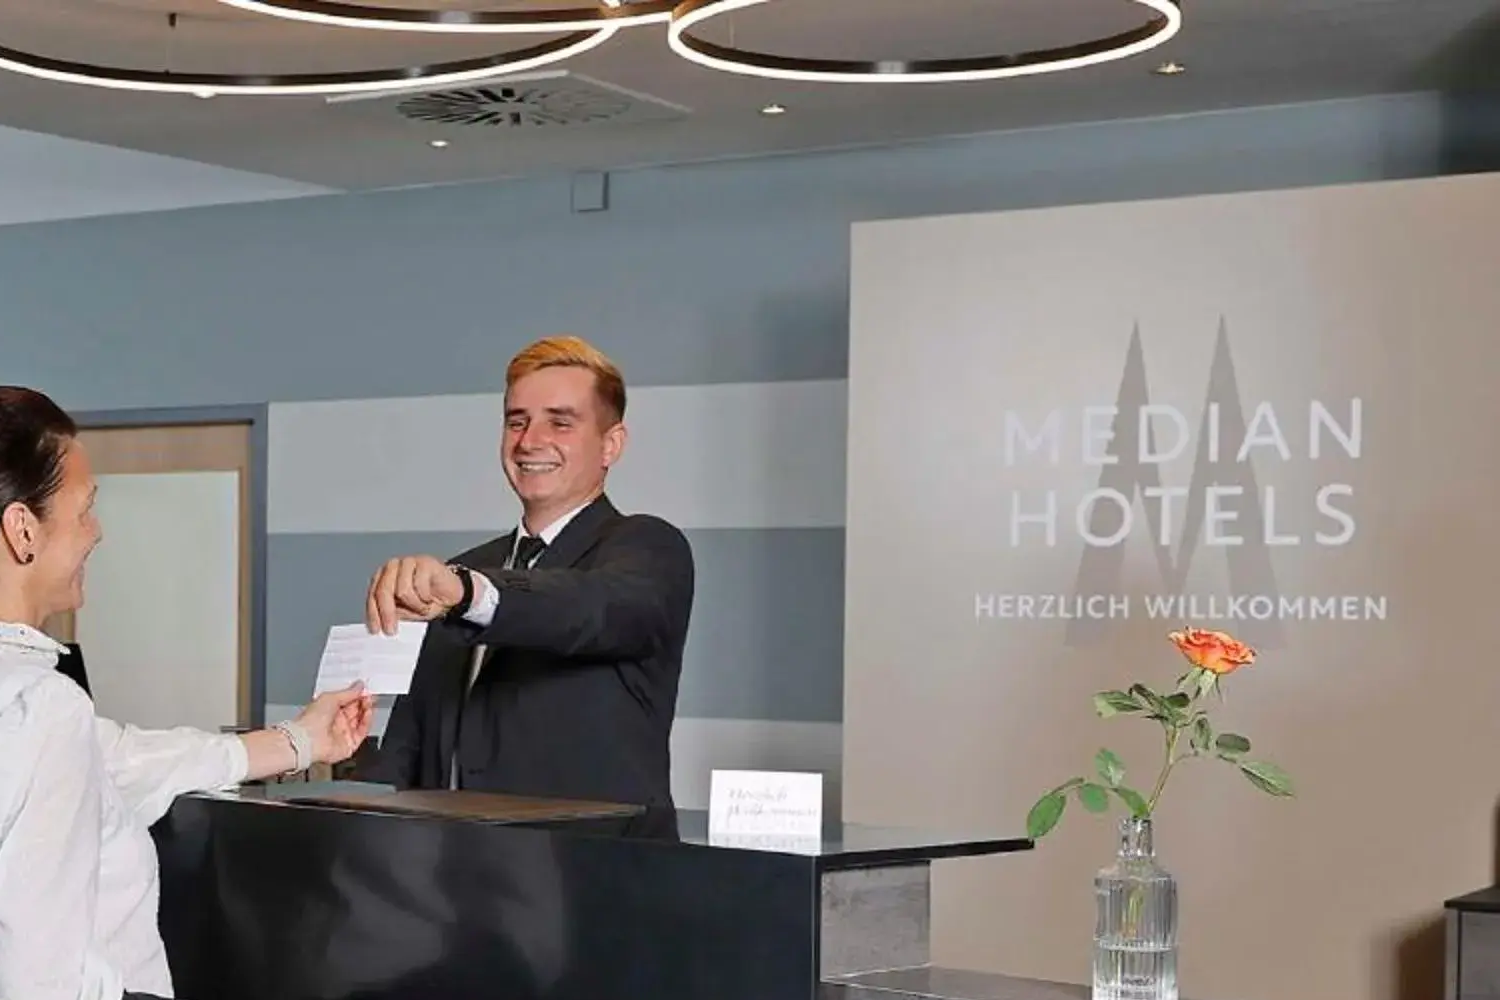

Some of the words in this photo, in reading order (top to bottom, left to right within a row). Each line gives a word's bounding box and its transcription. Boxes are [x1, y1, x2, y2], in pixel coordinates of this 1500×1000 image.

[1004, 397, 1363, 467] MEDIAN
[1009, 483, 1356, 548] HOTELS
[974, 593, 1130, 621] HERZLICH
[1144, 593, 1388, 621] WILLKOMMEN
